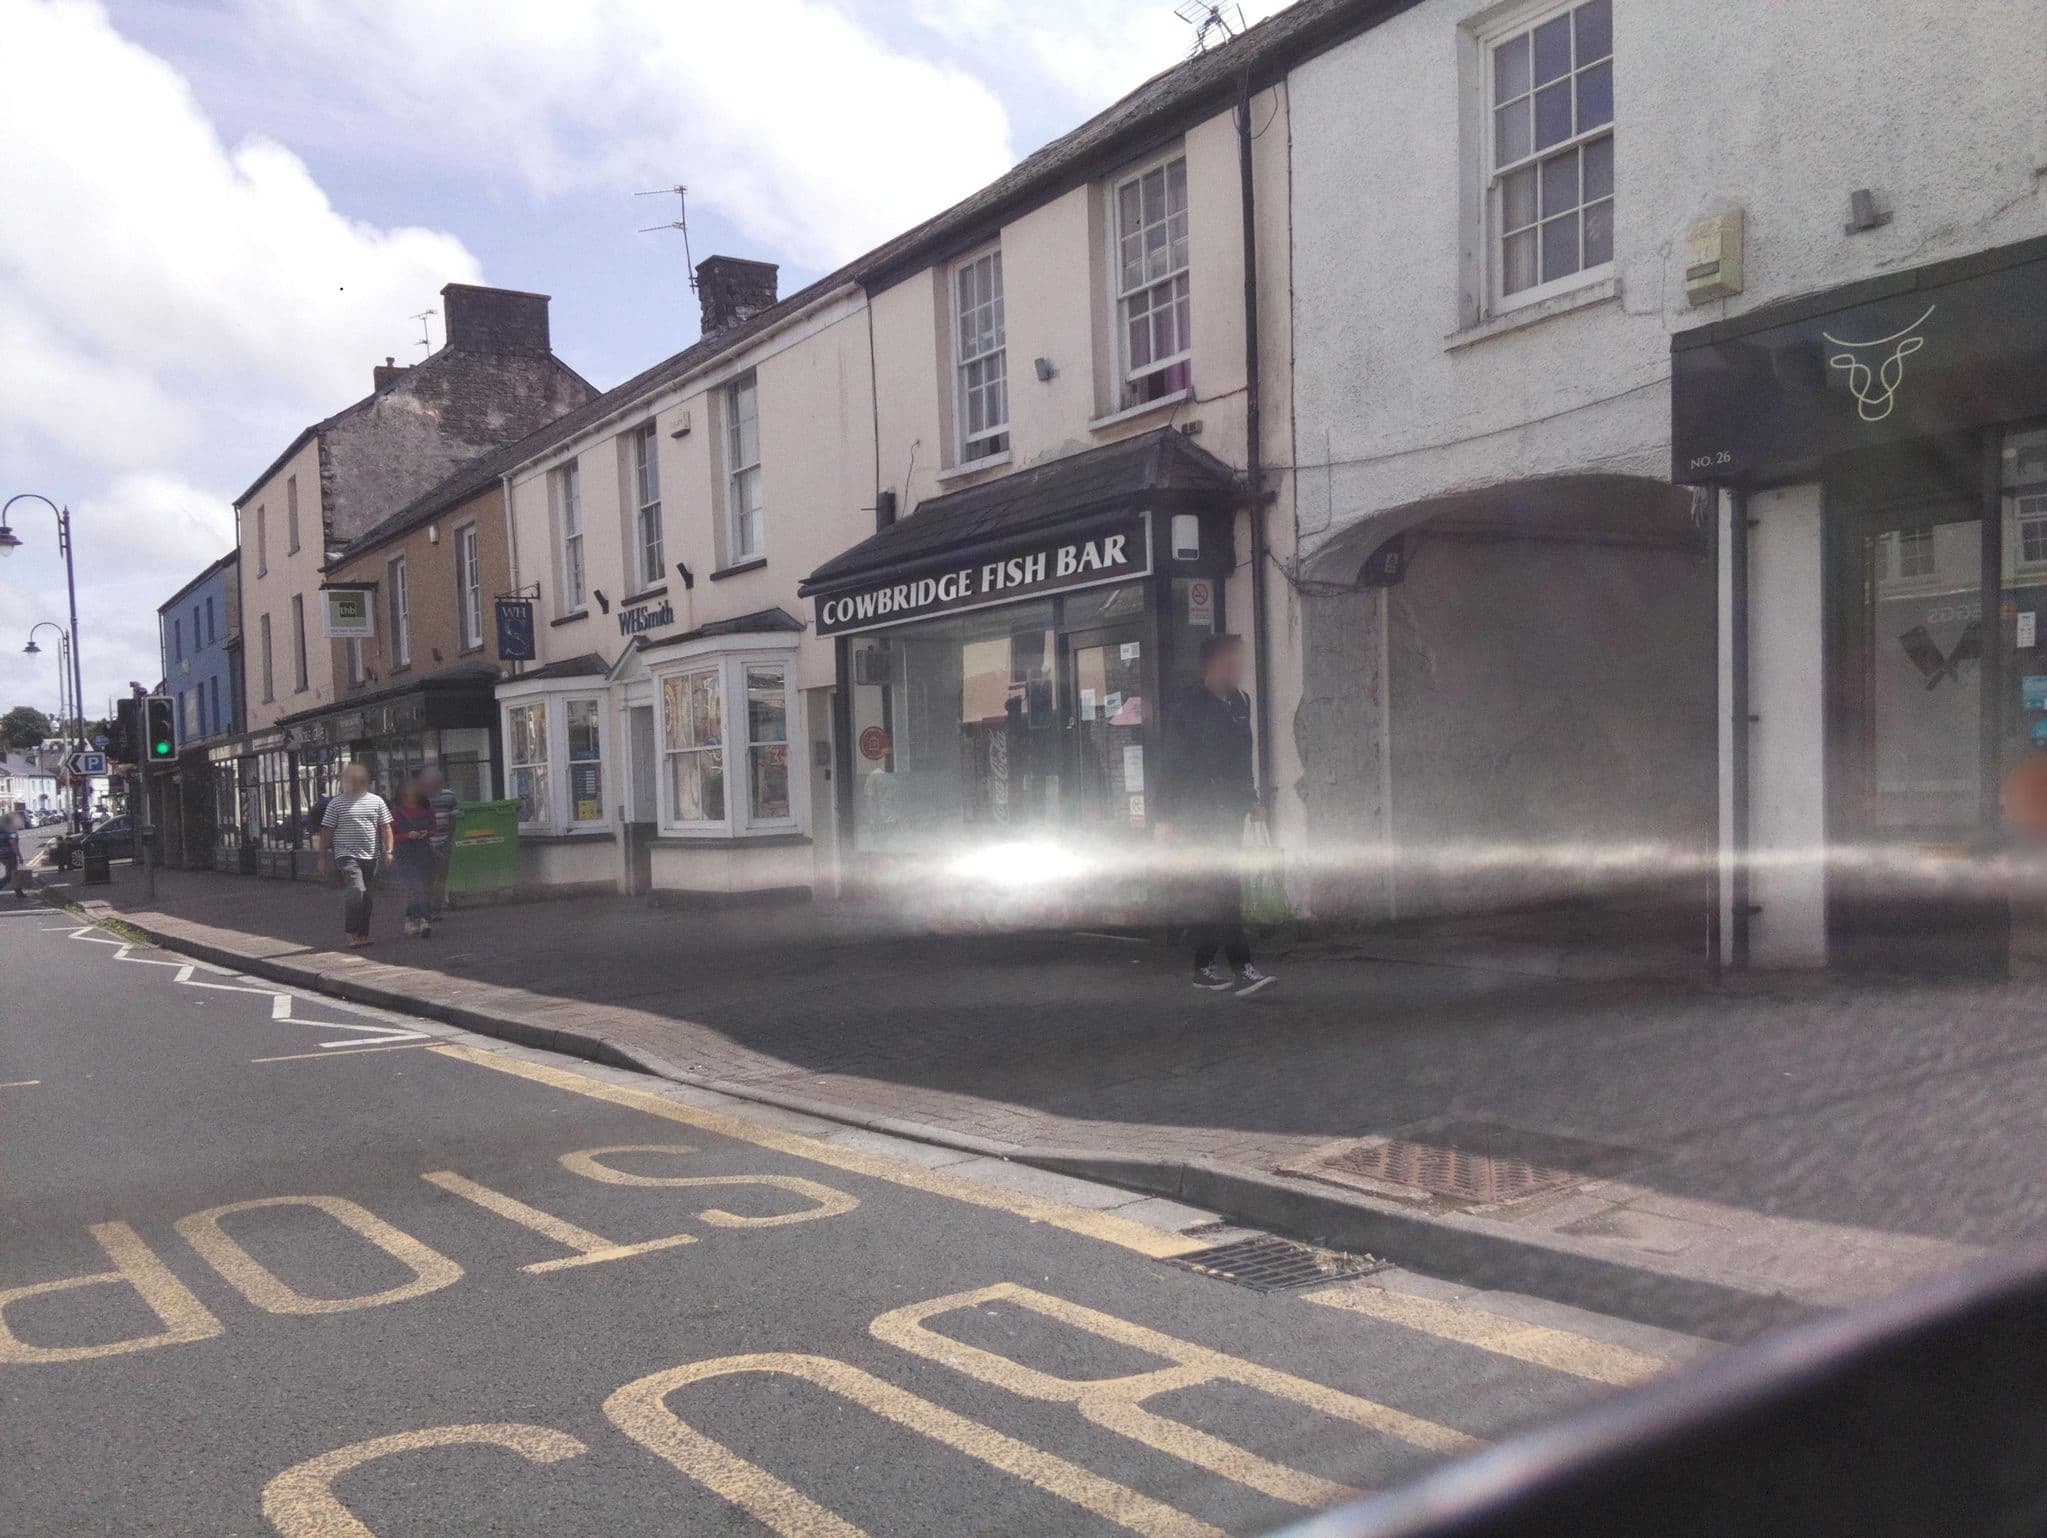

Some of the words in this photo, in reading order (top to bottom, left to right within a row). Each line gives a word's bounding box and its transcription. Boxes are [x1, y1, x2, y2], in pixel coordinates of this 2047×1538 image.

[1690, 456, 1713, 470] NO.
[1716, 450, 1731, 464] 26
[821, 568, 973, 625] COWBRIDGE
[980, 551, 1047, 593] FISH
[1055, 533, 1129, 578] BAR
[340, 605, 357, 615] thb
[502, 607, 527, 618] WH
[618, 599, 674, 636] WHSmith
[87, 756, 100, 770] P
[0, 1145, 861, 1364] STOP
